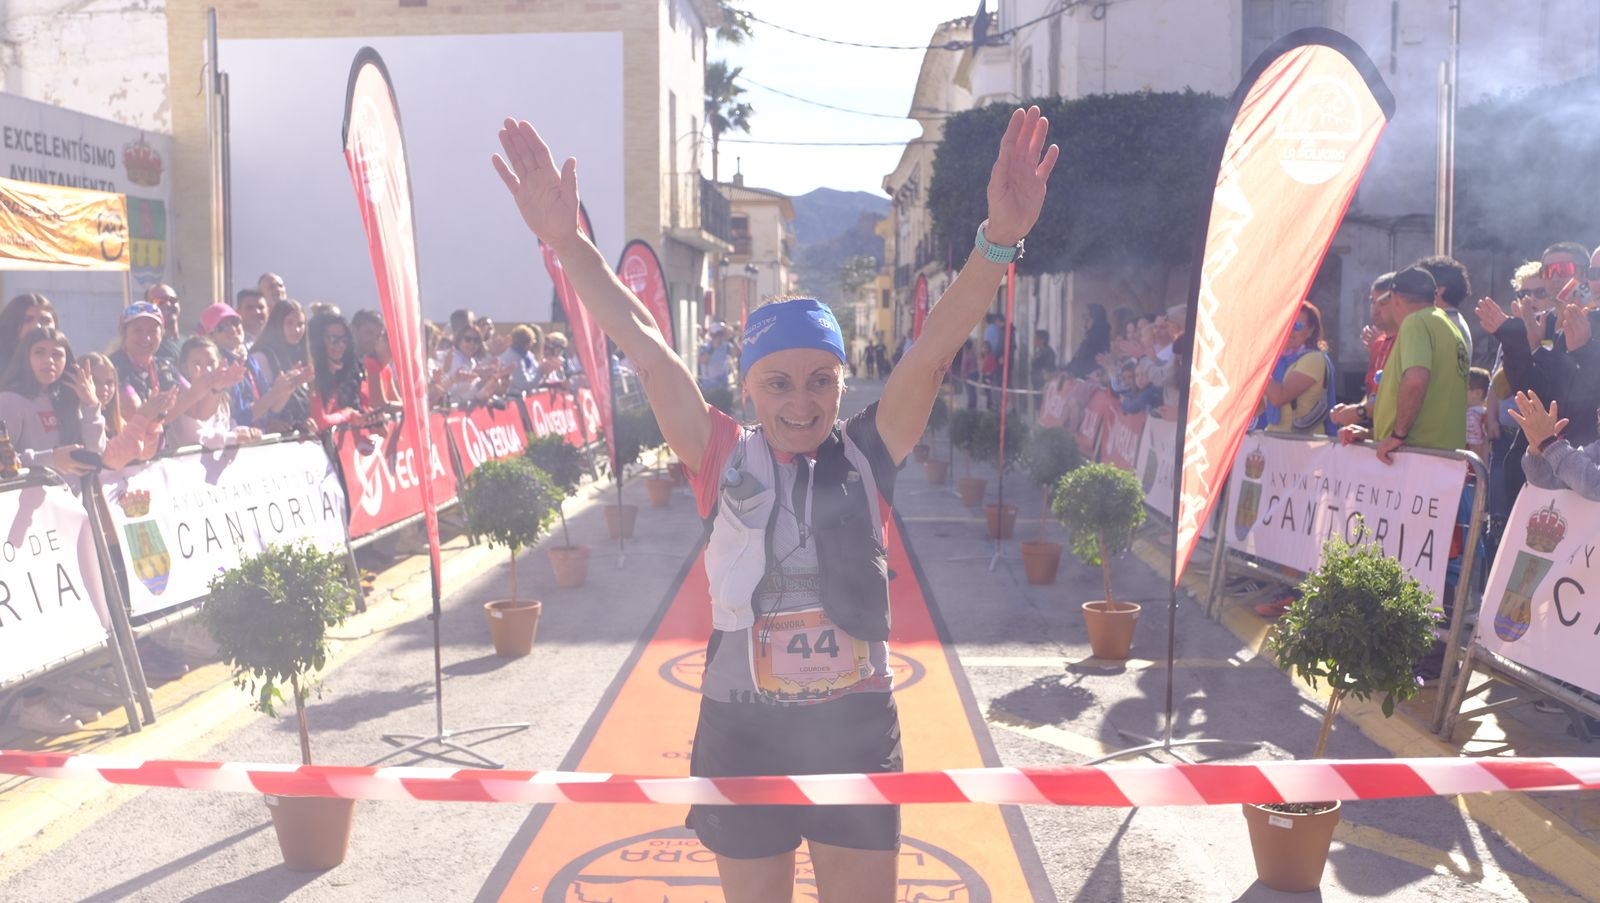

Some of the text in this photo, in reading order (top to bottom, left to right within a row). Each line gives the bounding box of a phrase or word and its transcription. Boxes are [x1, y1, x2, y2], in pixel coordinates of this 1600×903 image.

[3, 125, 116, 169] EXCELENTÍSIMO
[172, 473, 298, 513] AYUNTAMENT
[1411, 494, 1440, 519] DE
[28, 529, 61, 556] DE
[177, 490, 336, 559] CANTORIA
[1261, 494, 1434, 572] CANTORIA
[786, 628, 841, 659] 44
